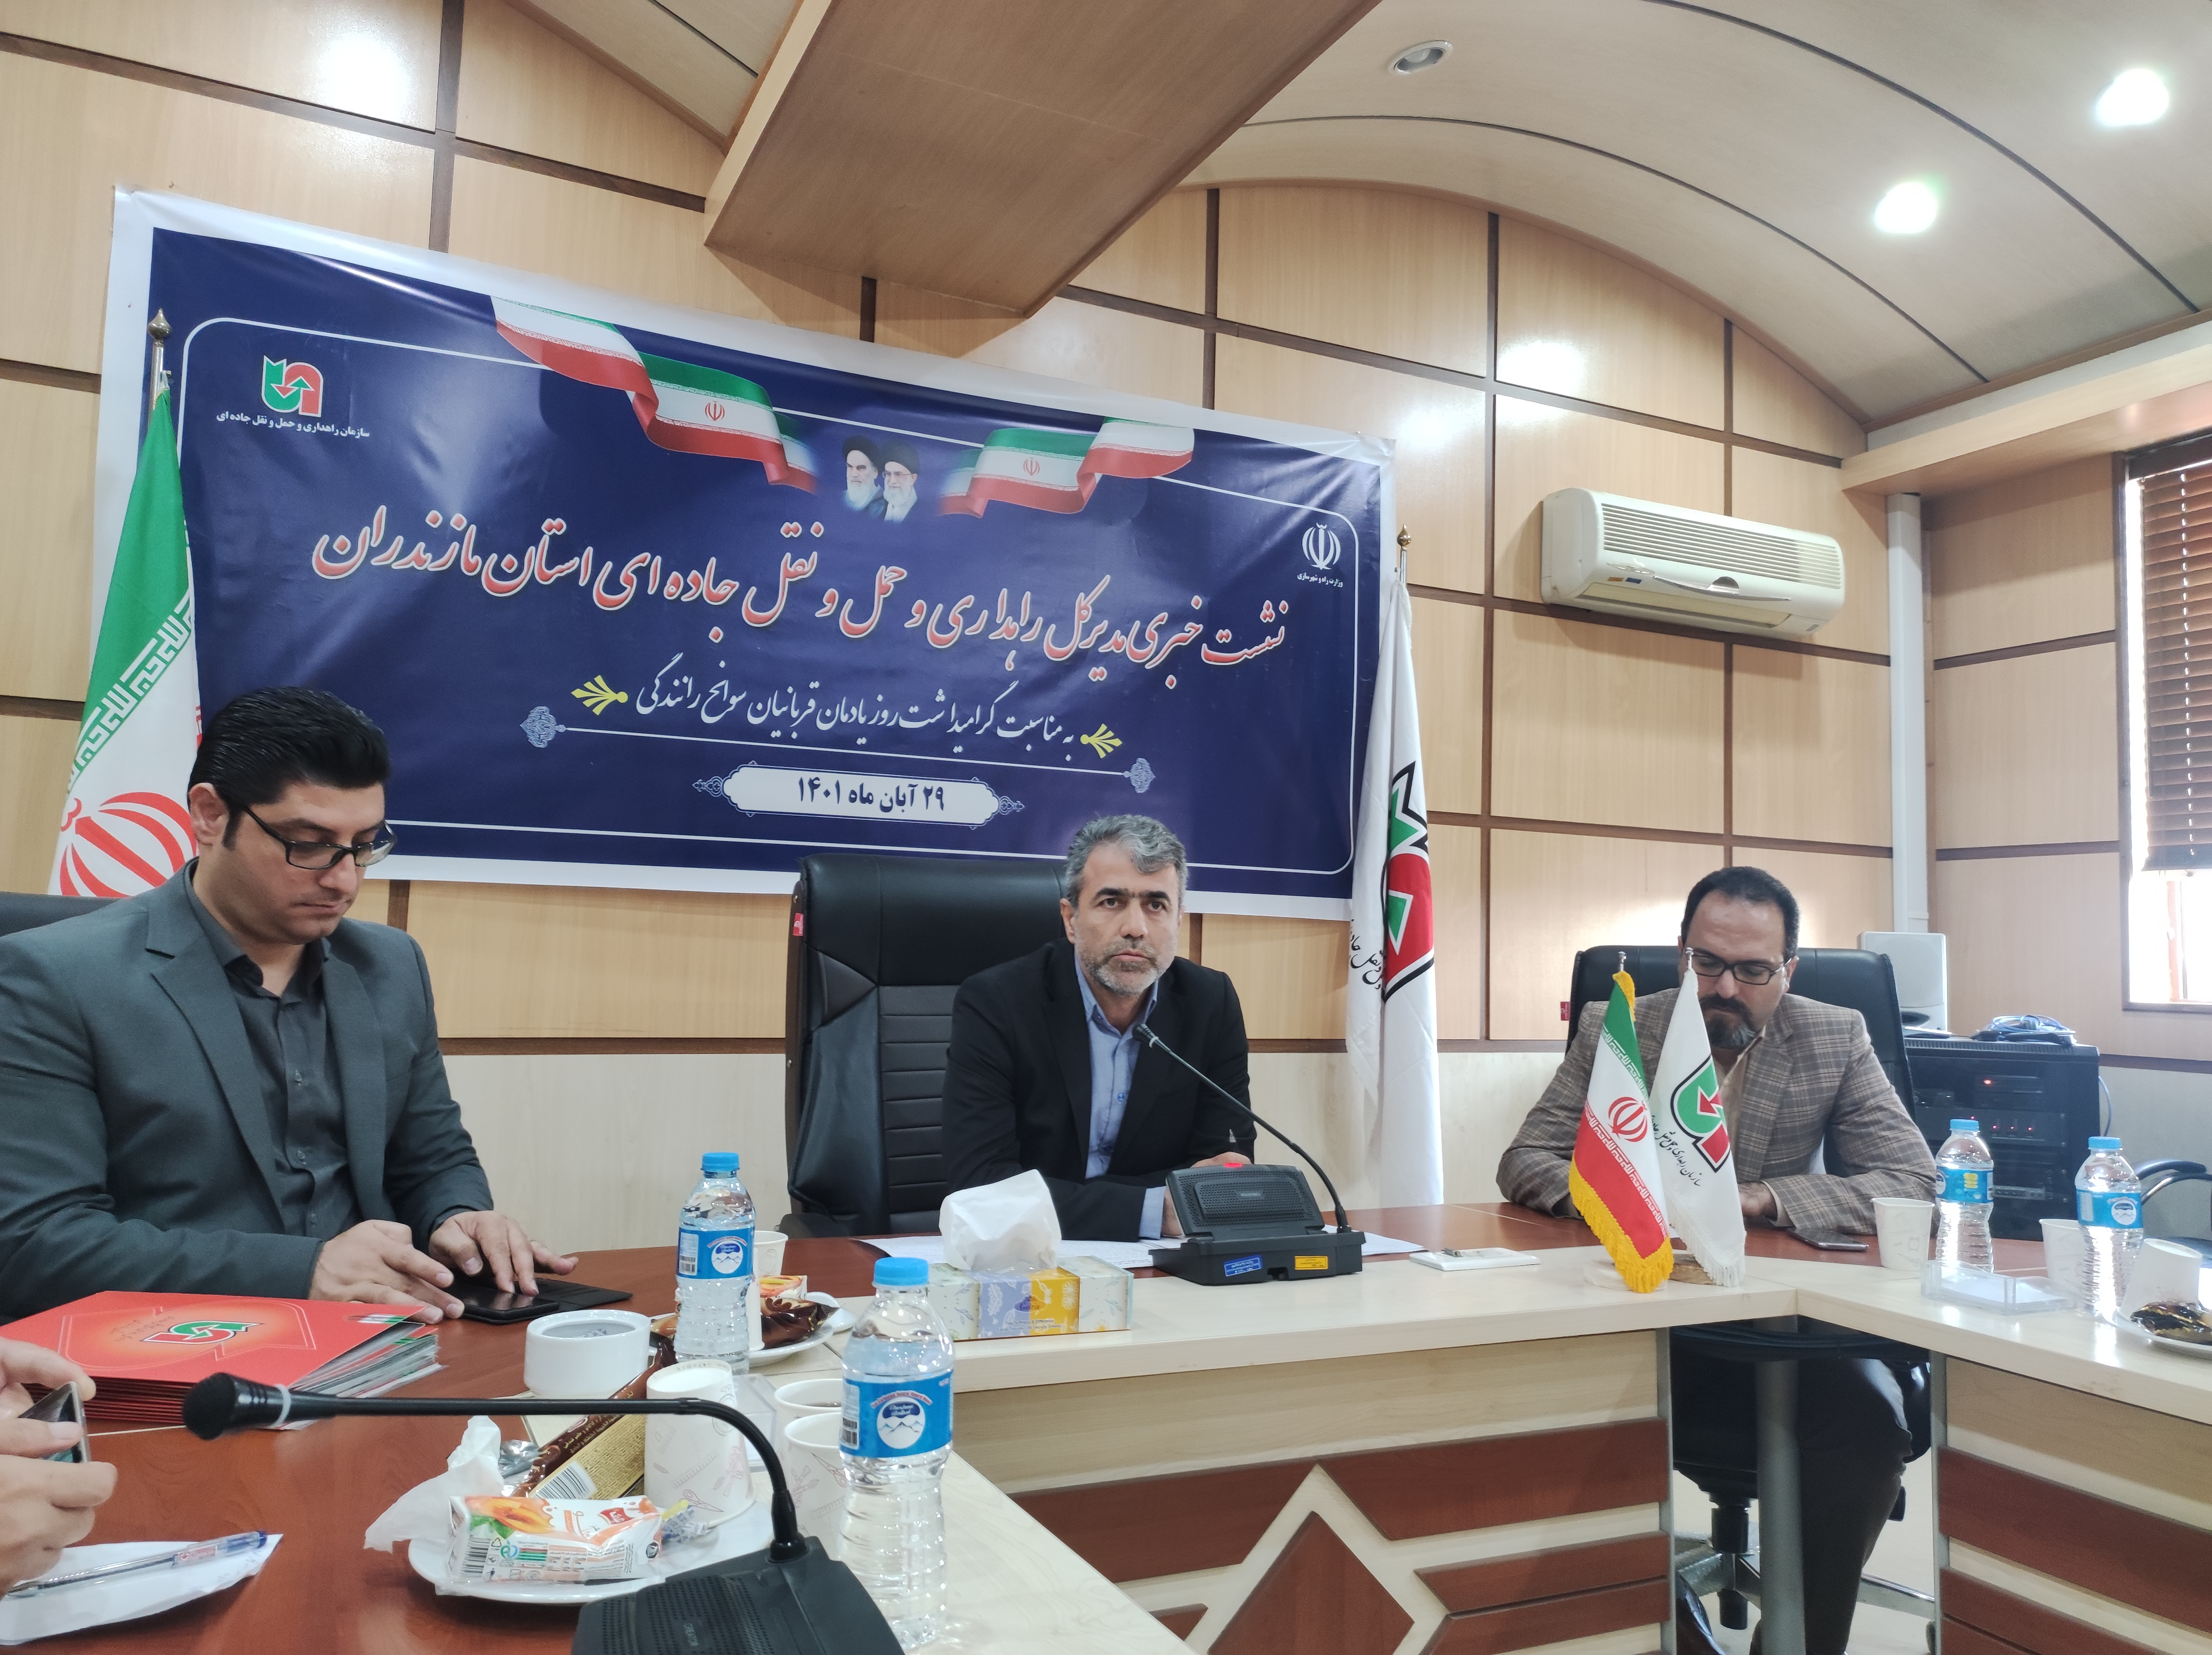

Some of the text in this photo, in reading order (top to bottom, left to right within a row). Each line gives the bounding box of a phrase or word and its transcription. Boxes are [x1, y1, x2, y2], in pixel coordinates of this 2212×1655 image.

[216, 411, 228, 422] ای
[230, 413, 251, 424] جاده
[252, 415, 267, 426] نقل
[268, 419, 274, 428] و
[275, 418, 296, 429] حمل
[303, 422, 339, 436] راهداری
[340, 426, 370, 438] سازمان
[312, 505, 481, 580] مازندران
[481, 518, 593, 597] استان
[593, 552, 661, 611] ای
[742, 521, 824, 627] نقل
[1297, 572, 1318, 582] شهرسازی
[1329, 578, 1343, 588] وزارت
[664, 557, 739, 643] جاده
[815, 588, 839, 617] و
[839, 565, 907, 638] حمل
[904, 599, 926, 628] و
[927, 588, 1043, 671] راهداری
[1126, 595, 1203, 689] خبری
[1201, 600, 1289, 665] نشست
[636, 652, 701, 714] رانندگی
[701, 660, 747, 723] سوانح
[747, 681, 819, 739] قربانیان
[816, 696, 866, 745] یادمان
[868, 694, 898, 726] روز
[997, 715, 1062, 751] مناسبت
[1062, 735, 1074, 761] به
[799, 776, 944, 813] ۲۹ آبان ماه ۱۴۰۱
[1680, 1168, 1702, 1186] سازمان
